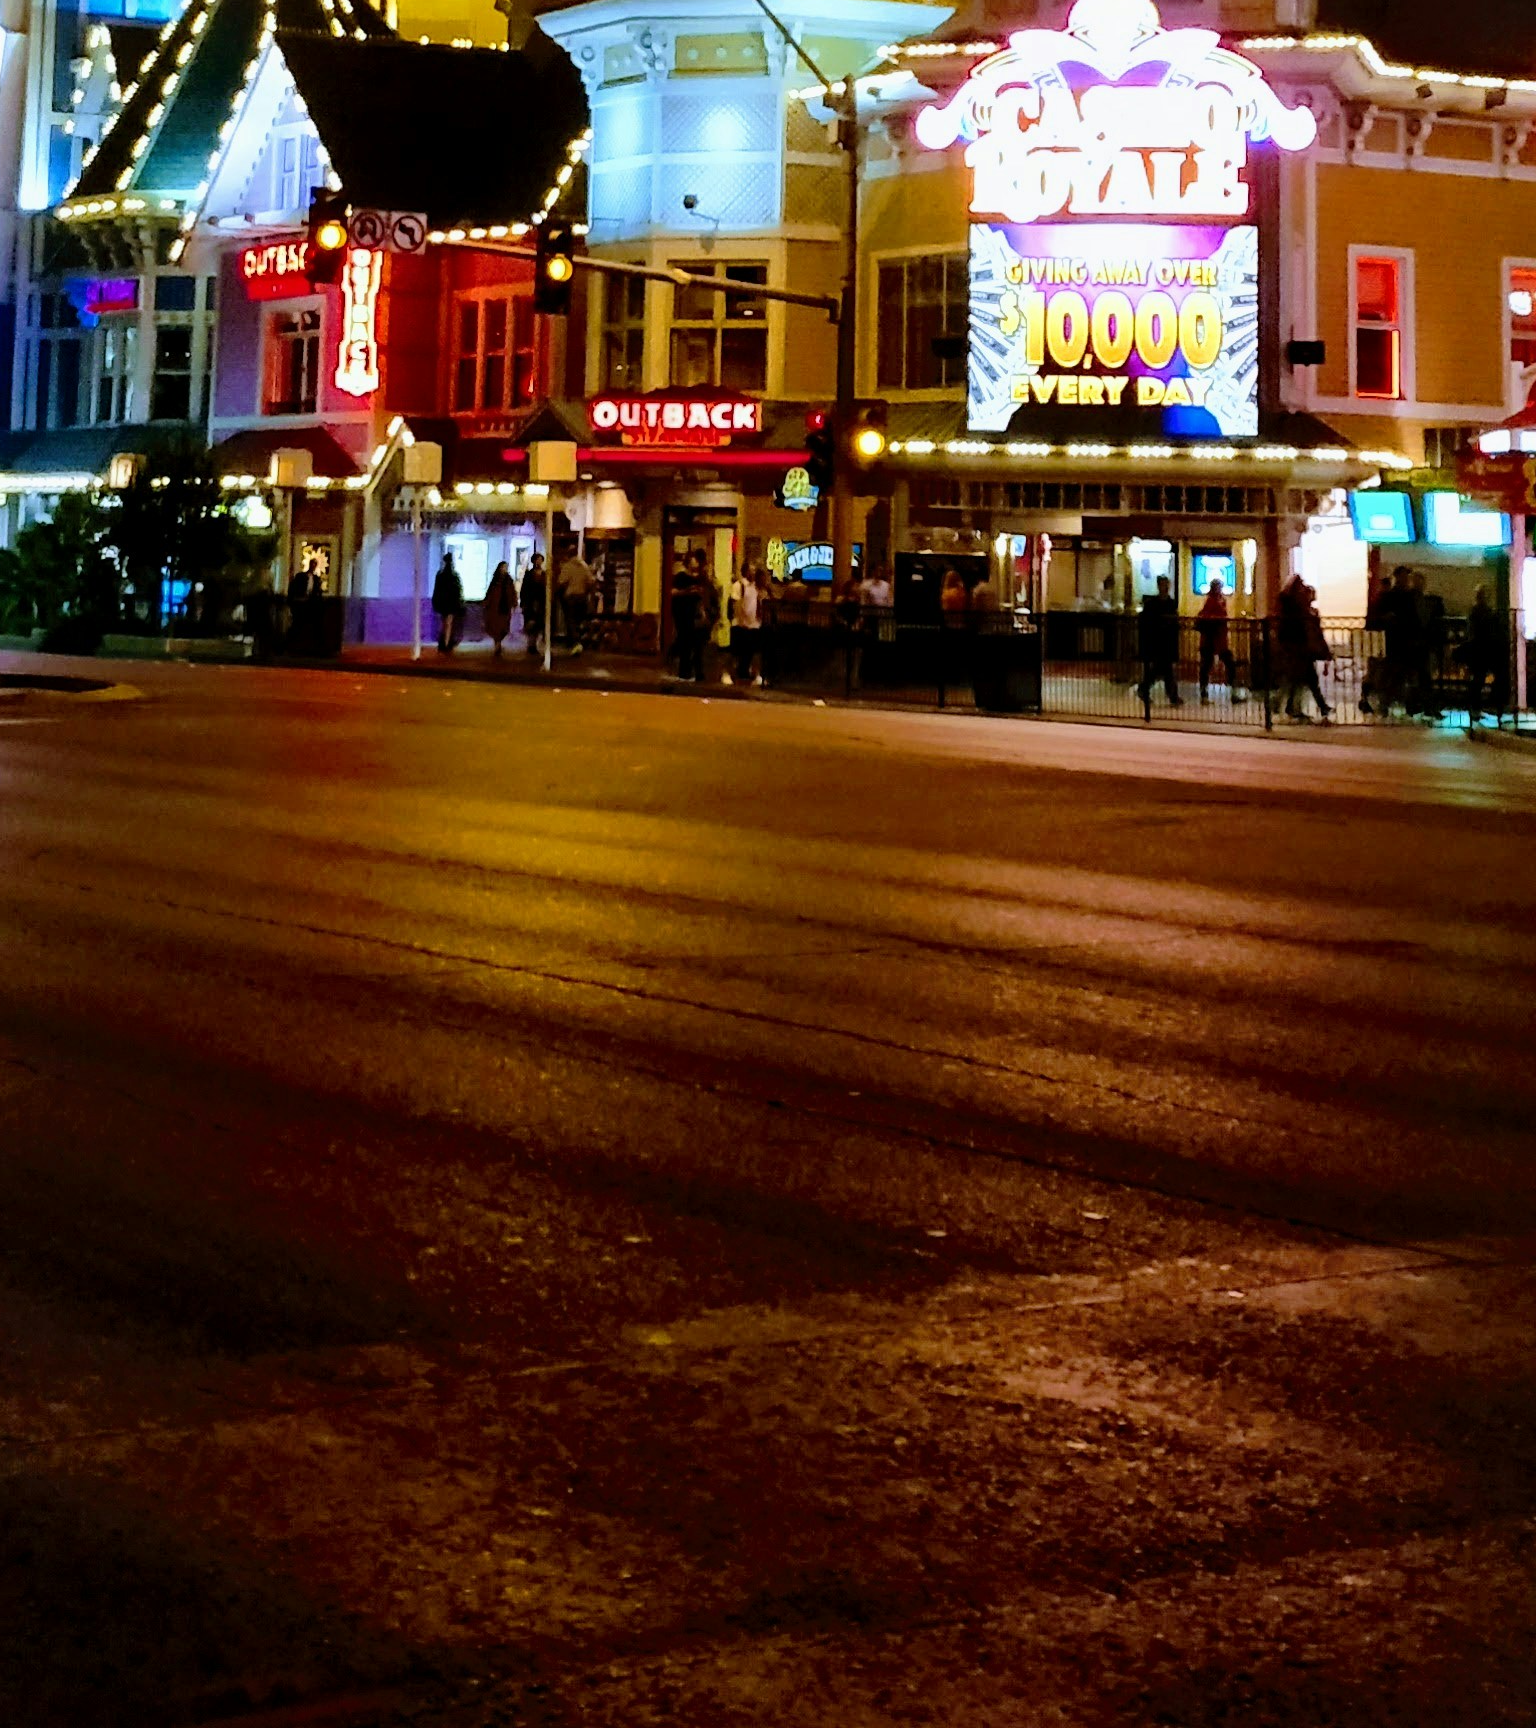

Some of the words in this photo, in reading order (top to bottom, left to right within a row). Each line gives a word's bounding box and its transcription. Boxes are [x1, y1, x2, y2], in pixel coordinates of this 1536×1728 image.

[1005, 257, 1088, 285] GIVING
[1090, 258, 1152, 286] AWAY
[1154, 258, 1219, 286] OVER
[999, 289, 1225, 370] $10,000
[1010, 374, 1129, 406] EVERY
[1136, 375, 1216, 406] DAY
[592, 399, 756, 430] OUTBACK
